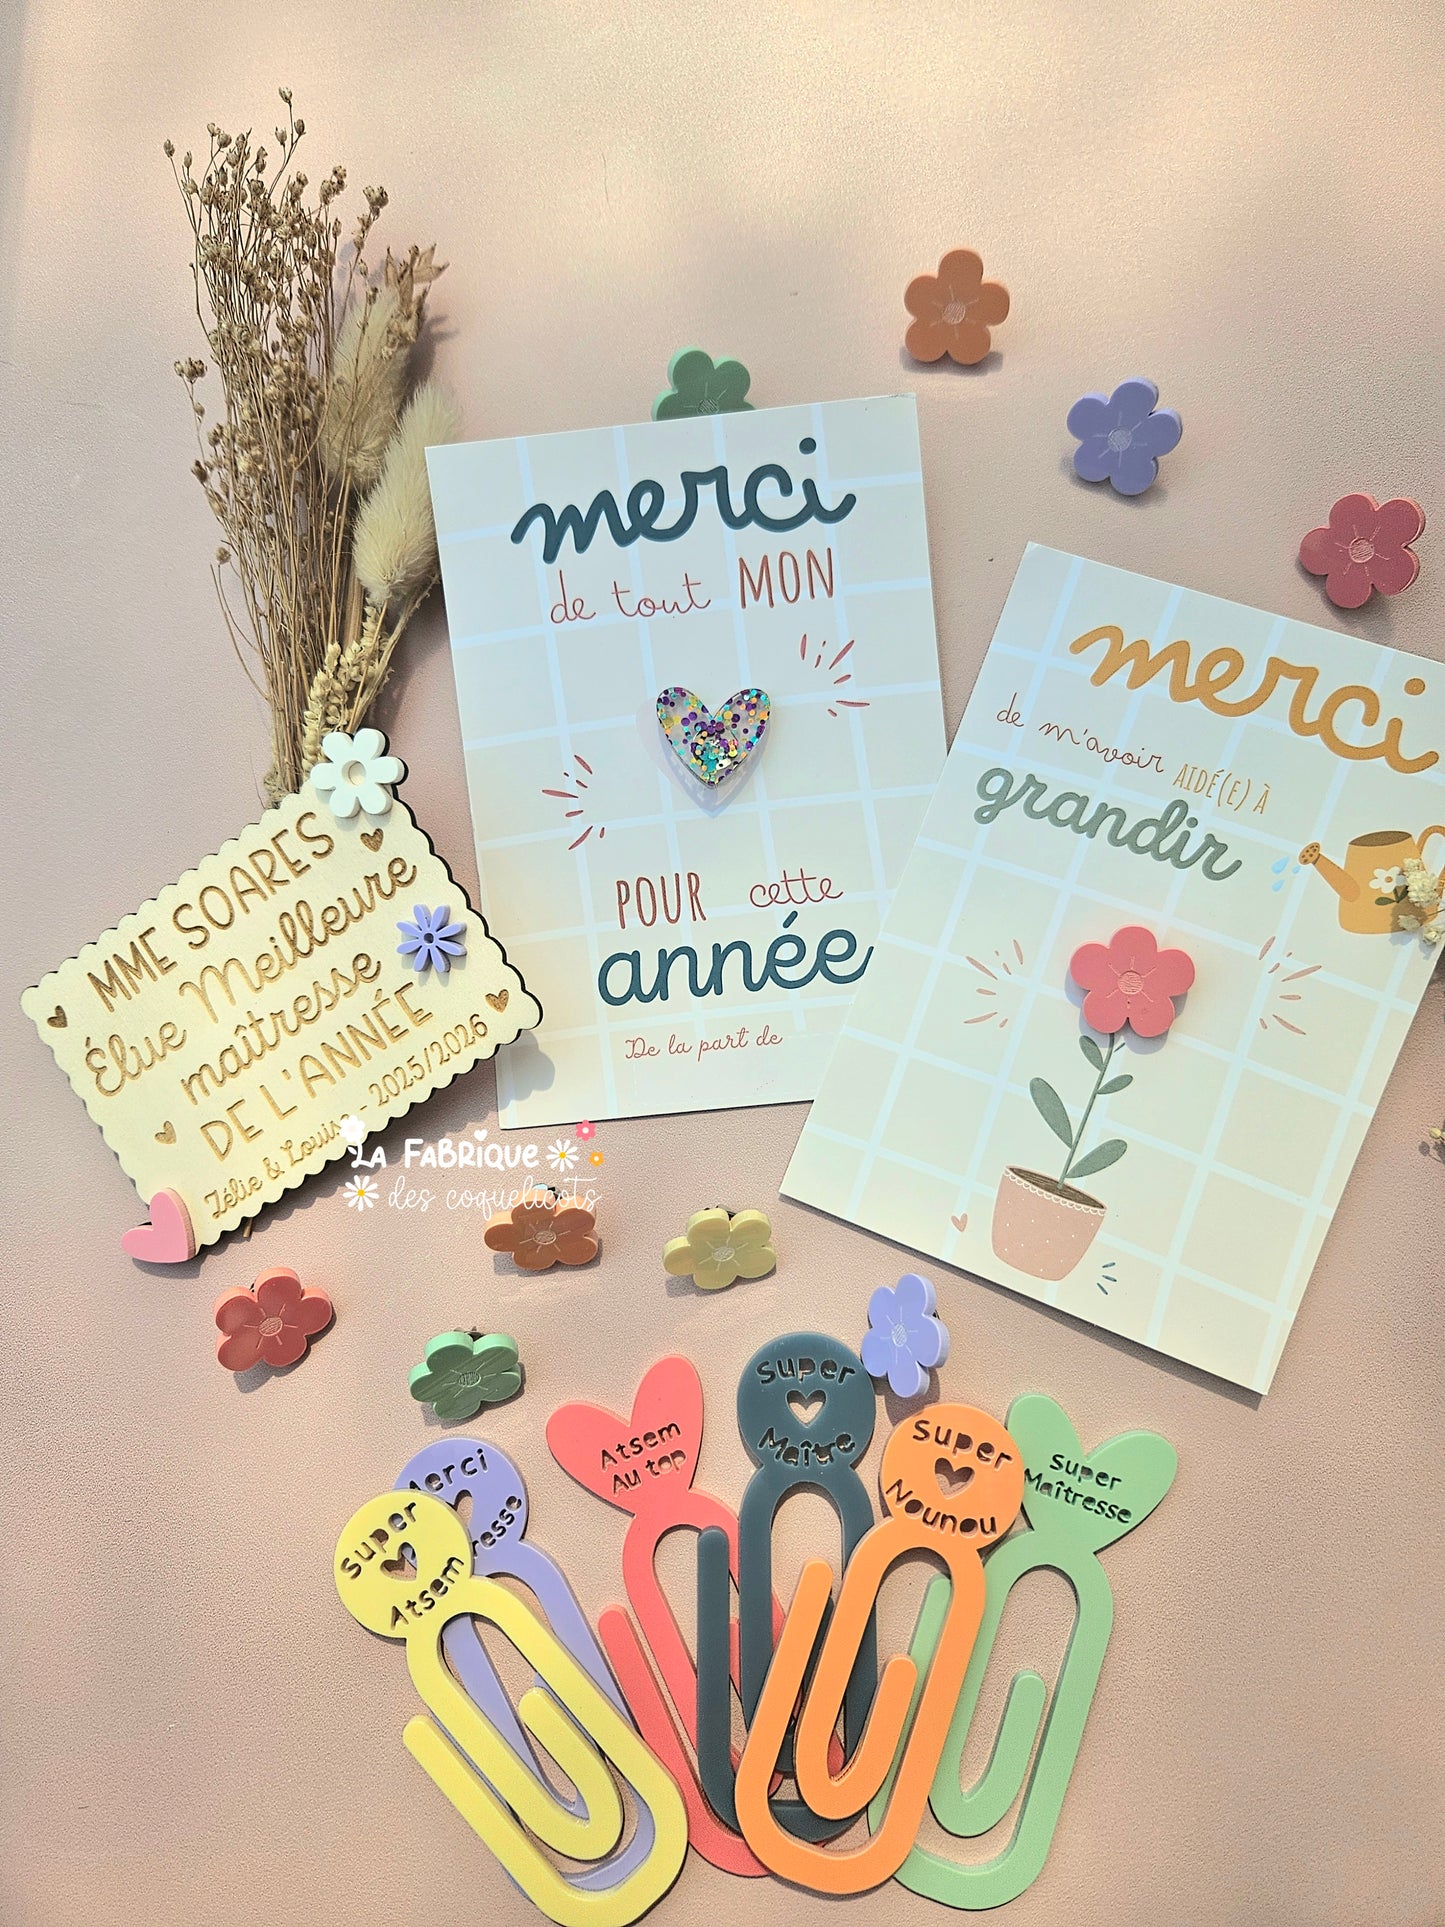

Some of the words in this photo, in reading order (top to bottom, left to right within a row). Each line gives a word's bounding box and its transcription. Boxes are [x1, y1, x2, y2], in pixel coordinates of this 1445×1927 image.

[511, 437, 857, 565] merci
[549, 570, 597, 624] de
[611, 573, 711, 618] tout
[738, 547, 836, 609] MON
[1069, 625, 1440, 774] merci
[996, 692, 1025, 727] de
[1038, 722, 1165, 773] m'avoir
[1172, 763, 1251, 812] AIDÉ(E)
[1253, 784, 1271, 814] À
[973, 767, 1243, 882] grandir
[86, 926, 177, 1014] MME
[172, 811, 336, 950] SOARES
[616, 872, 707, 929] POUR
[749, 868, 844, 908] cette
[84, 1021, 189, 1098] Élue
[179, 855, 418, 1024] Meilleure
[598, 910, 875, 1006] année
[180, 952, 382, 1106] maîtresse
[625, 1037, 661, 1059] De
[668, 1033, 693, 1055] la
[697, 1027, 750, 1062] part
[756, 1025, 784, 1047] de
[200, 1098, 264, 1162] DE
[259, 981, 434, 1120] L'ANNÉE
[203, 1176, 263, 1219] Zélie
[262, 1157, 285, 1181] &
[368, 1013, 489, 1107] 2025/2026
[756, 1357, 857, 1386] Super
[600, 1421, 681, 1472] Atsem
[612, 1468, 640, 1497] Au
[648, 1448, 687, 1480] top
[758, 1426, 856, 1467] Maître
[912, 1419, 1014, 1470] Super
[1049, 1453, 1122, 1491] Super
[886, 1479, 999, 1537] Nounou
[1024, 1467, 1132, 1524] Maîtresse
[340, 1501, 419, 1580] Super
[391, 1555, 465, 1631] Atsem
